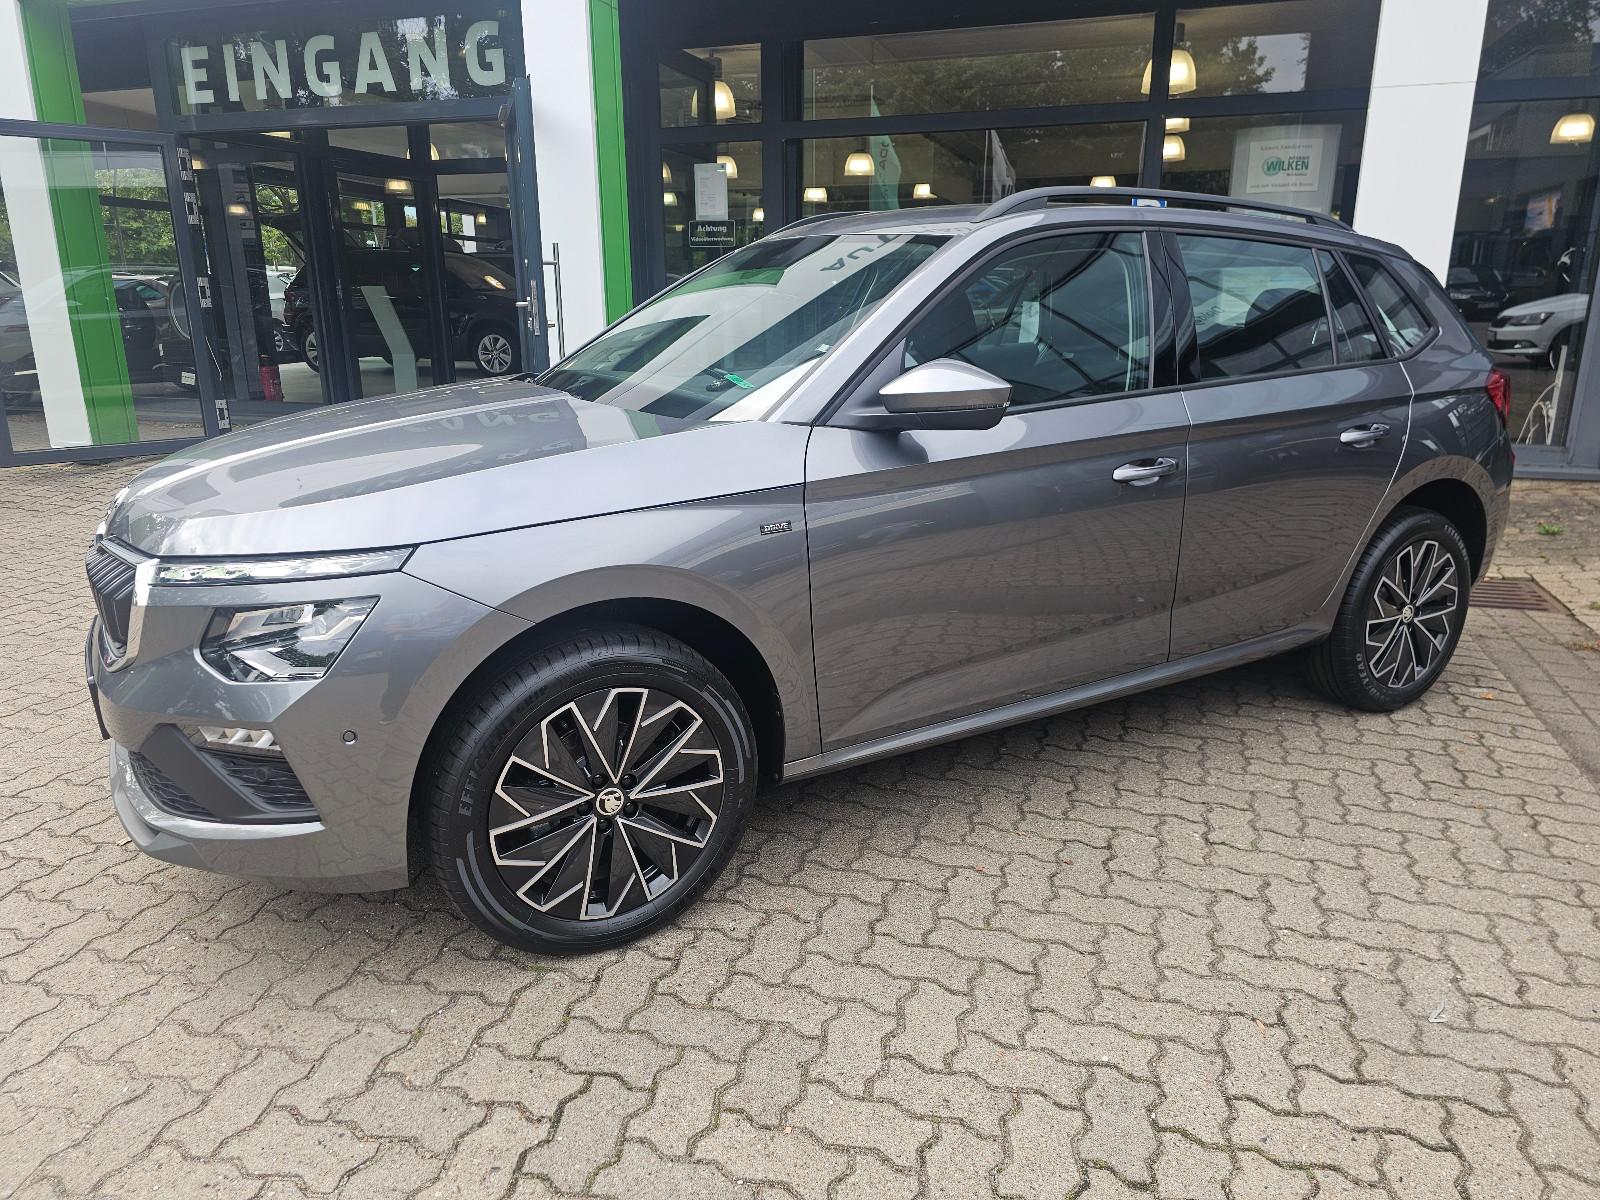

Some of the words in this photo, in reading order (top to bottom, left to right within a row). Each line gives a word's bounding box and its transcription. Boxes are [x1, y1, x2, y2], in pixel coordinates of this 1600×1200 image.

[180, 20, 506, 105] EINGANG
[1266, 160, 1309, 171] WILKEN
[697, 224, 727, 233] Achtung
[764, 522, 789, 532] DRIVE
